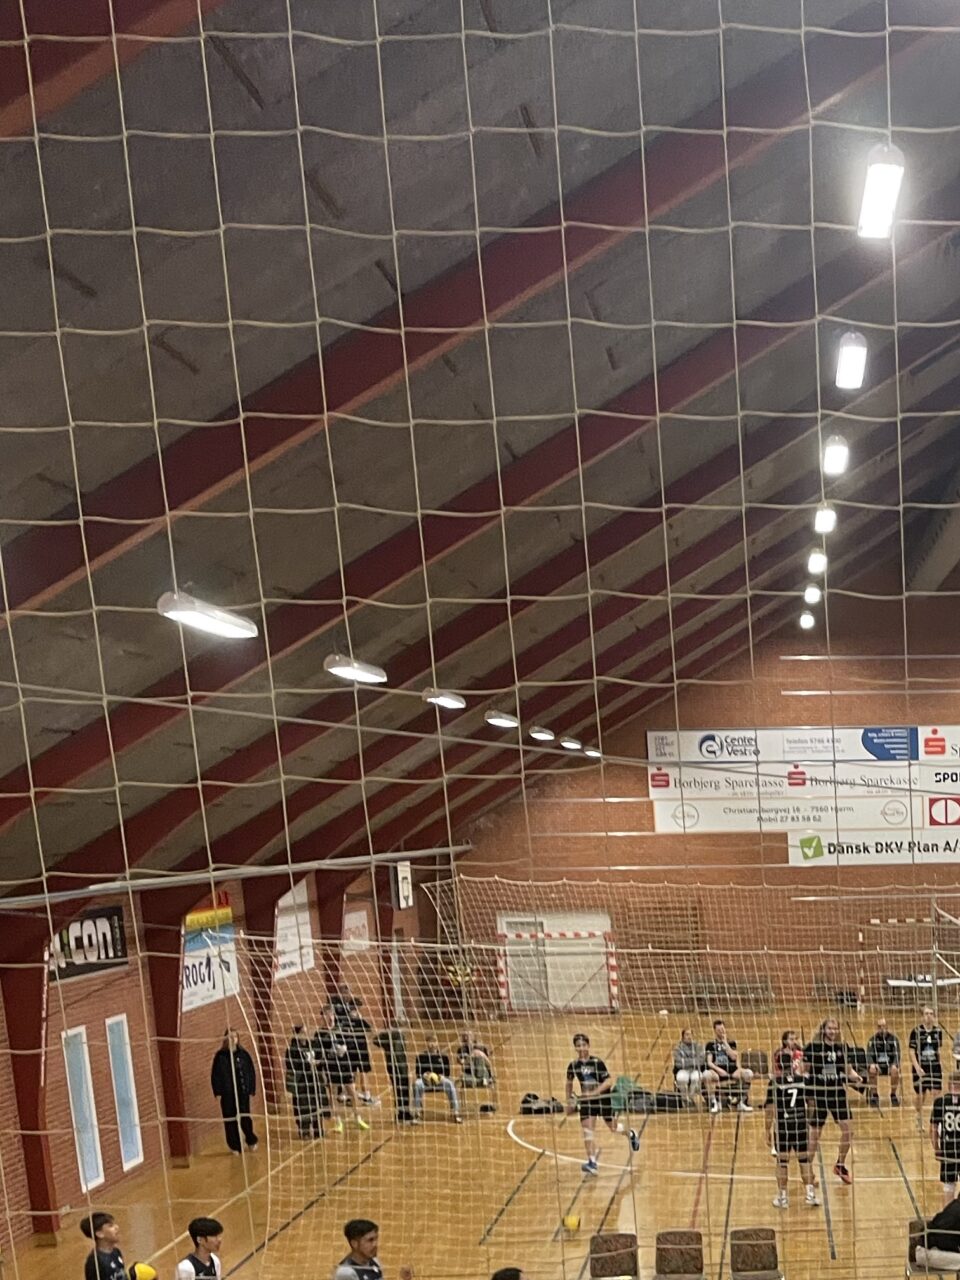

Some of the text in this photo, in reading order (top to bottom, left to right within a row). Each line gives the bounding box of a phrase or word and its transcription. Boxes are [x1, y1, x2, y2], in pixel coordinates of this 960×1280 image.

[723, 806, 790, 815] Christianborgvej
[828, 842, 871, 855] Dansk
[875, 841, 904, 854] DKV
[908, 840, 938, 853] Plan
[787, 1089, 798, 1108] 7
